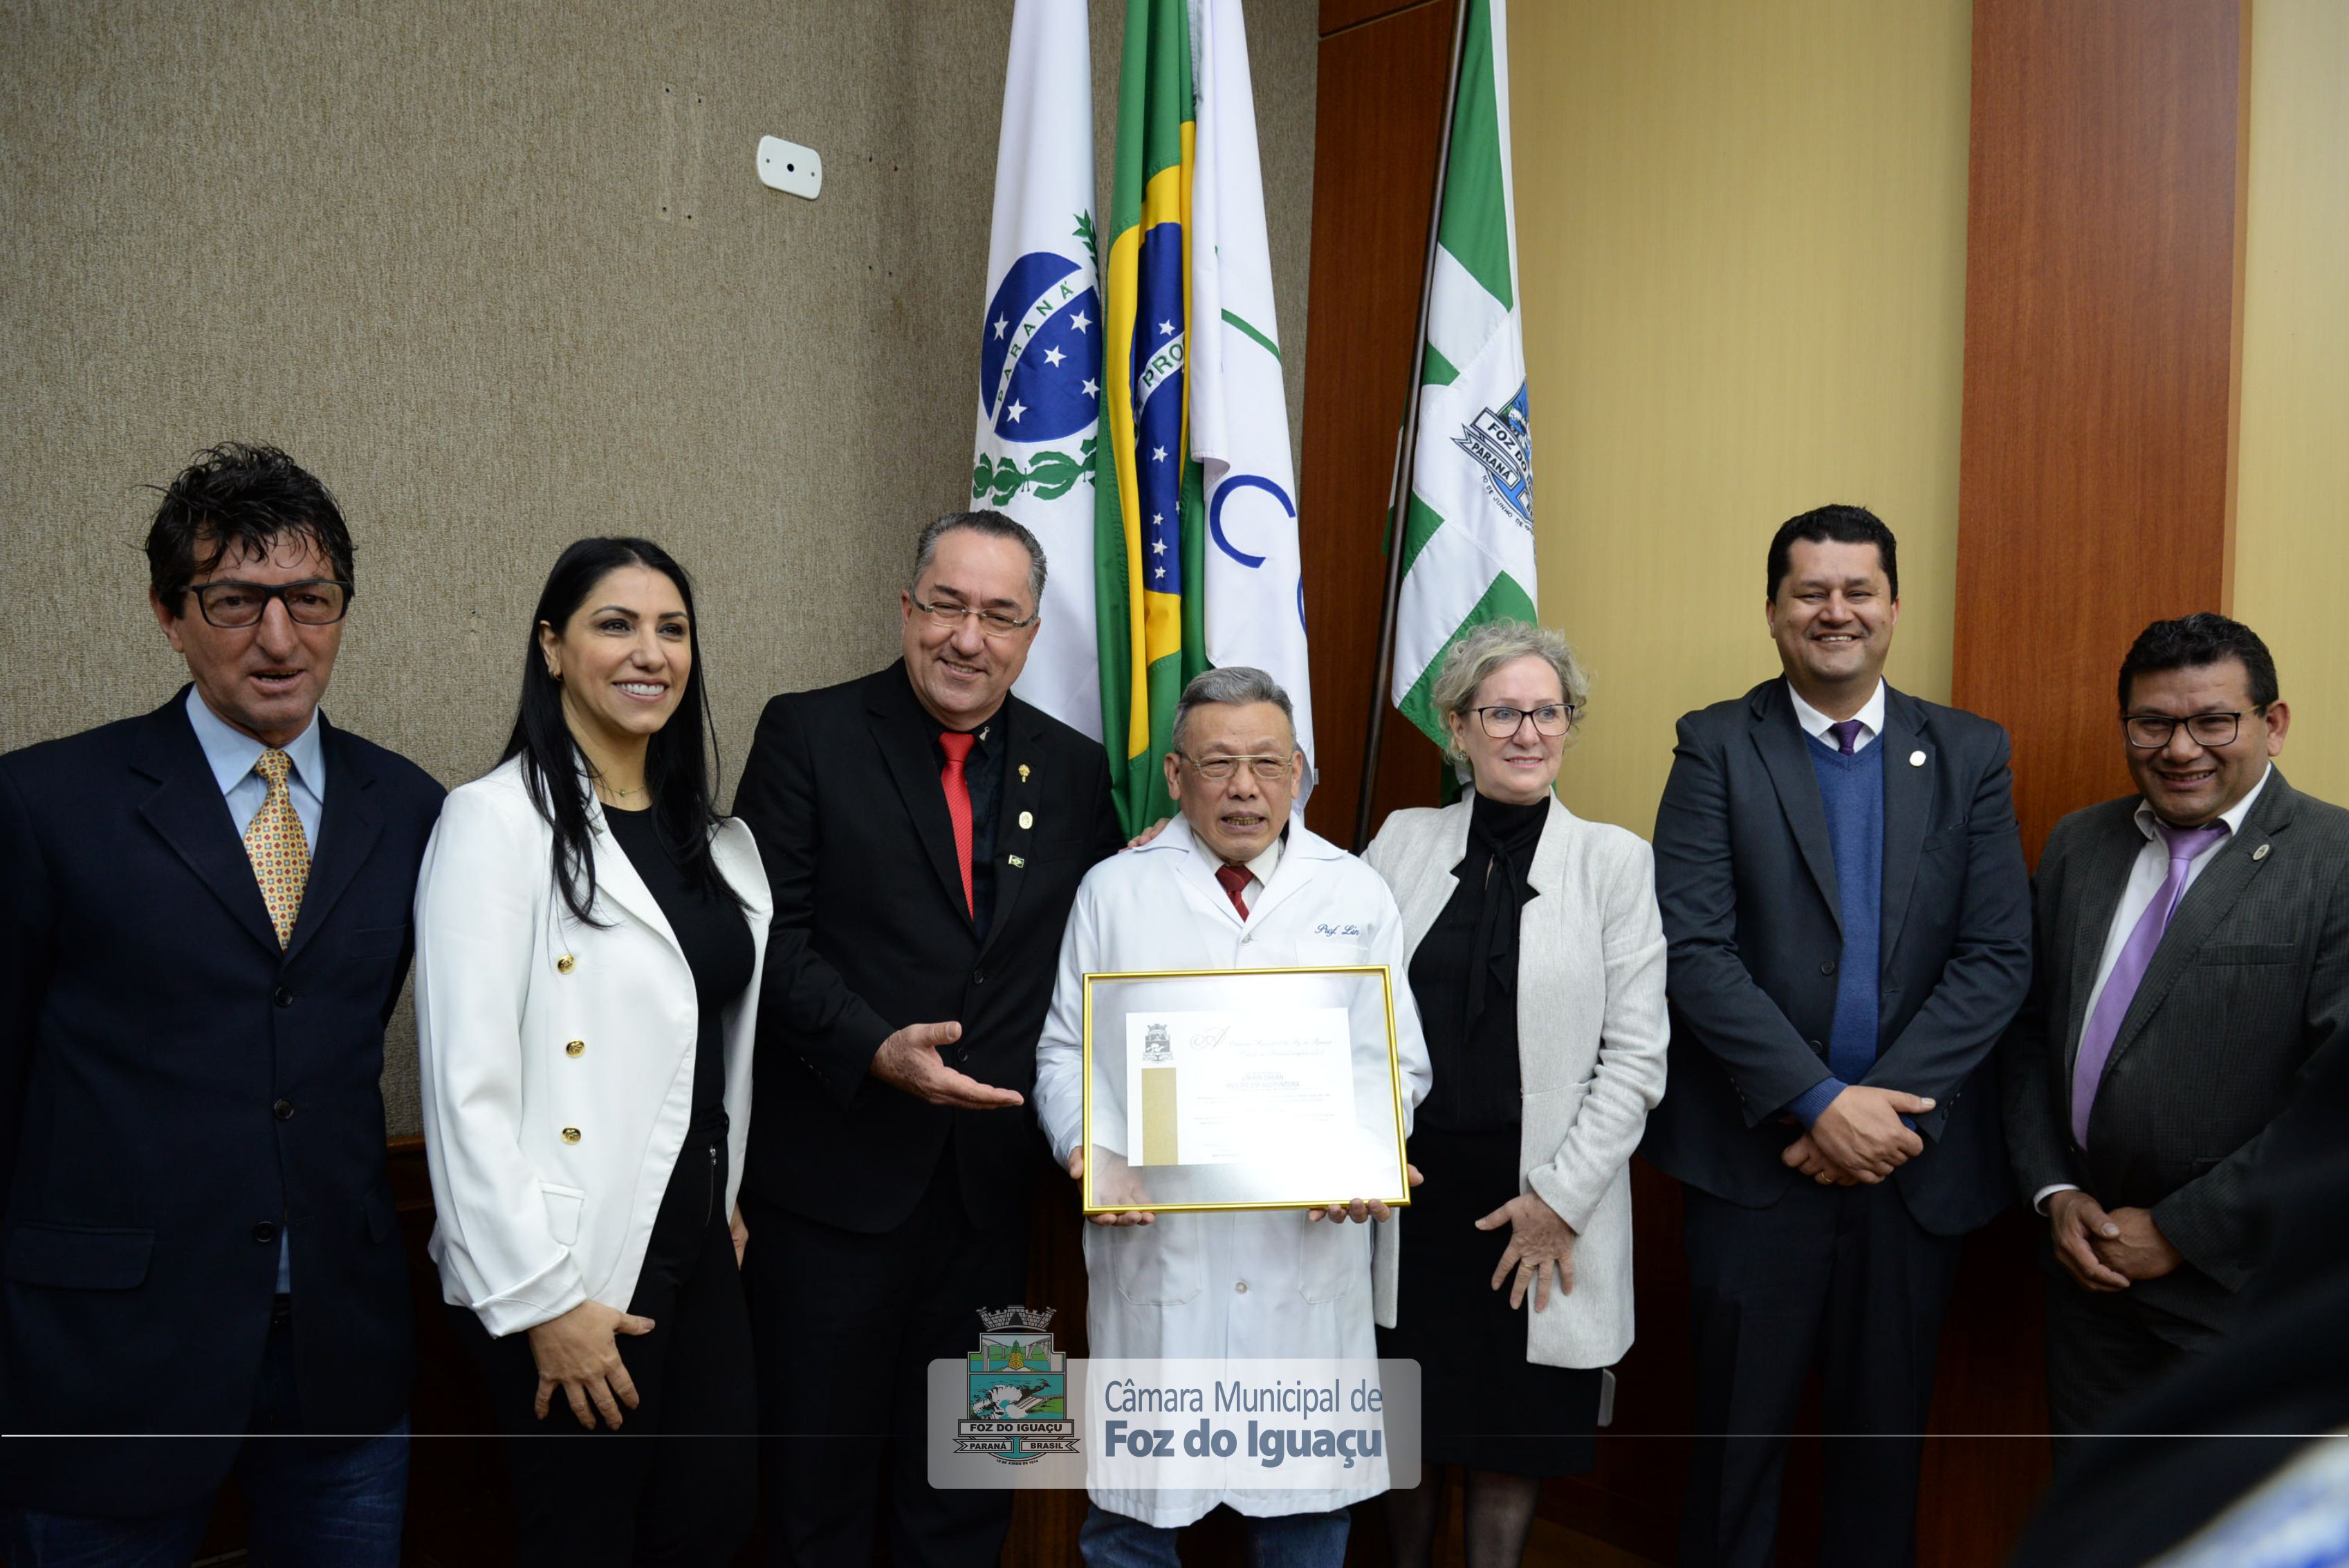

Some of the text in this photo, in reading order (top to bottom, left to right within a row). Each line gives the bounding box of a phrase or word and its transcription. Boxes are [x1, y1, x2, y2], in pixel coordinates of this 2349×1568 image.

[997, 280, 1074, 403] PARANÁ
[1142, 341, 1185, 388] PRO
[1472, 443, 1511, 480] PARANÁ
[1488, 422, 1527, 472] FOZ DO
